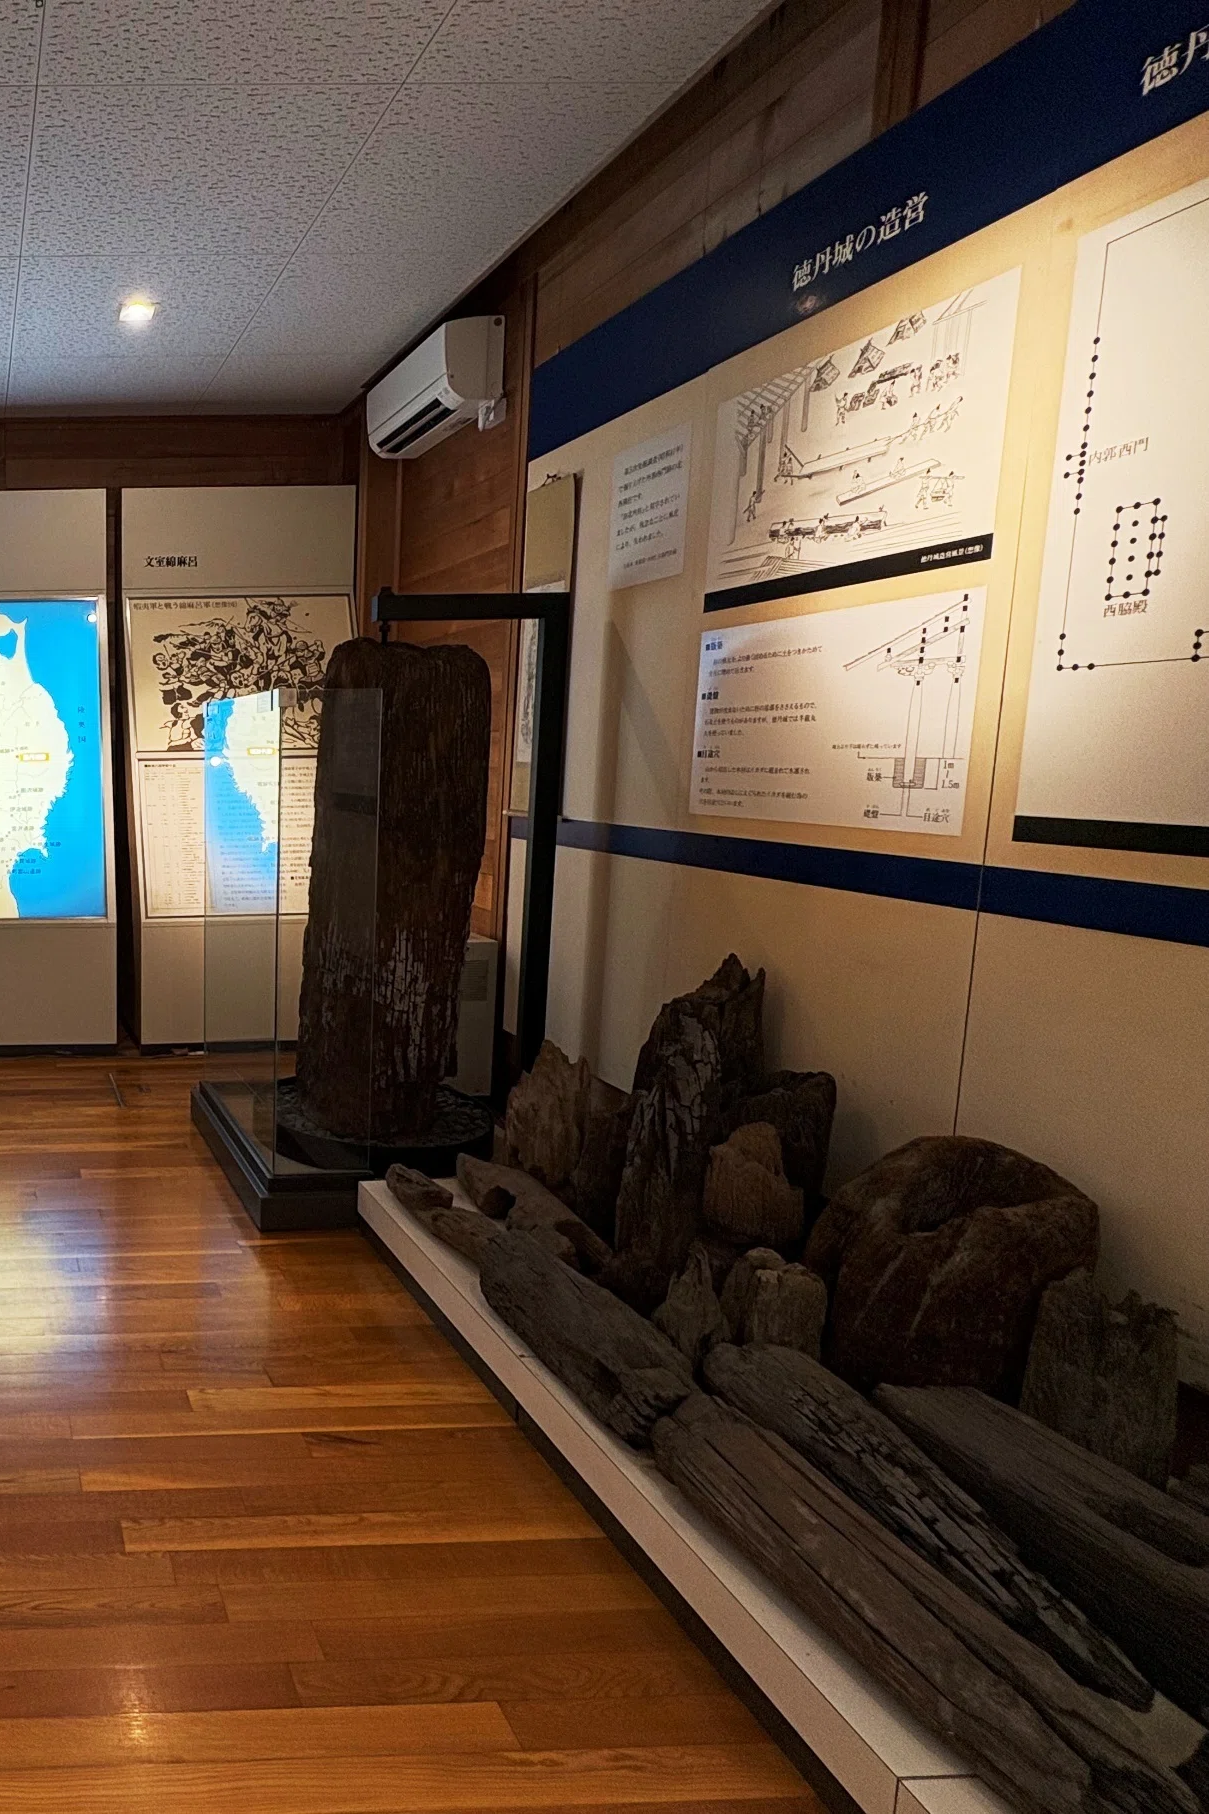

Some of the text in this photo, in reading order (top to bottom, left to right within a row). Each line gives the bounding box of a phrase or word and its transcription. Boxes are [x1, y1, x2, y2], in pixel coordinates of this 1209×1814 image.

[792, 191, 929, 292] 徳丹城の造営
[1089, 437, 1149, 466] 内郭西門
[144, 555, 199, 568] 文室綿麻呂
[1103, 599, 1148, 618] 西脇殿
[943, 761, 954, 769] 1m
